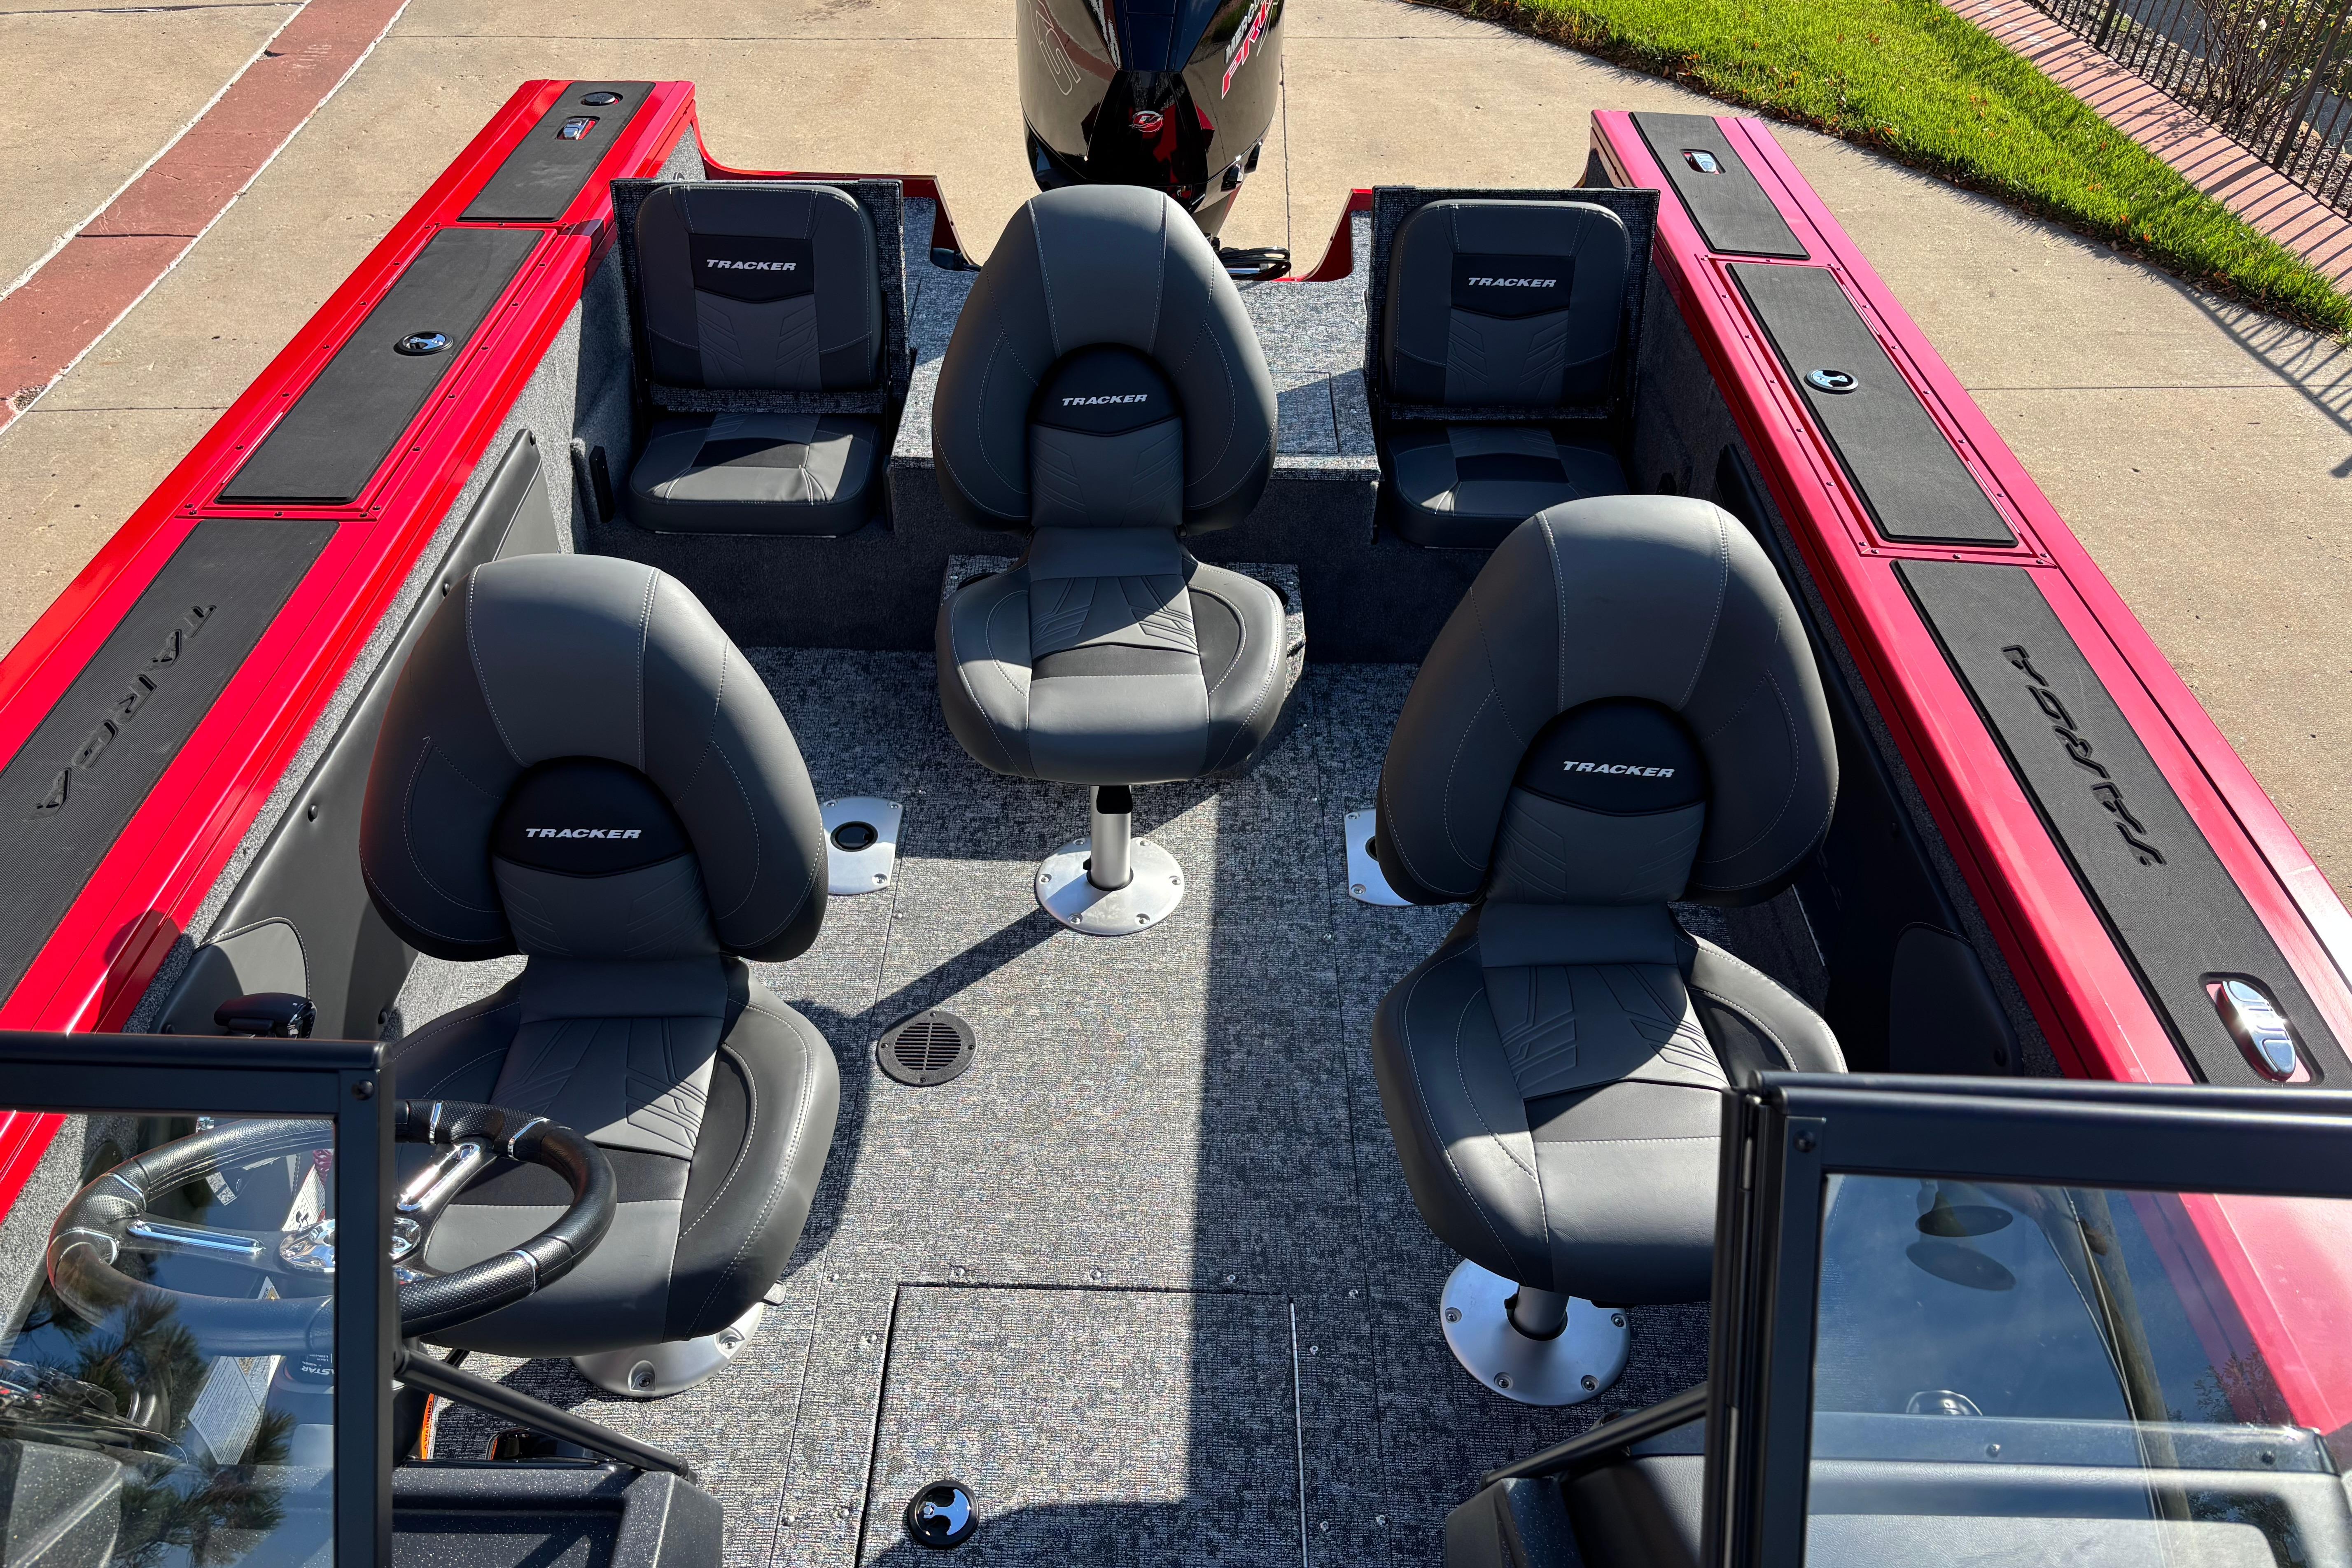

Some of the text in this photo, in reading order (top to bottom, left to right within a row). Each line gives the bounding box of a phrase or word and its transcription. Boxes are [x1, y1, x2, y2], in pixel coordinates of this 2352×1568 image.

[707, 259, 796, 271] TRACKER
[1468, 277, 1556, 287] TRACKER
[1062, 394, 1148, 406] TRACKER
[24, 604, 217, 821] TARGA
[2000, 645, 2167, 866] TARGA
[1563, 761, 1675, 778] TRACKER
[525, 828, 642, 839] TRACKER
